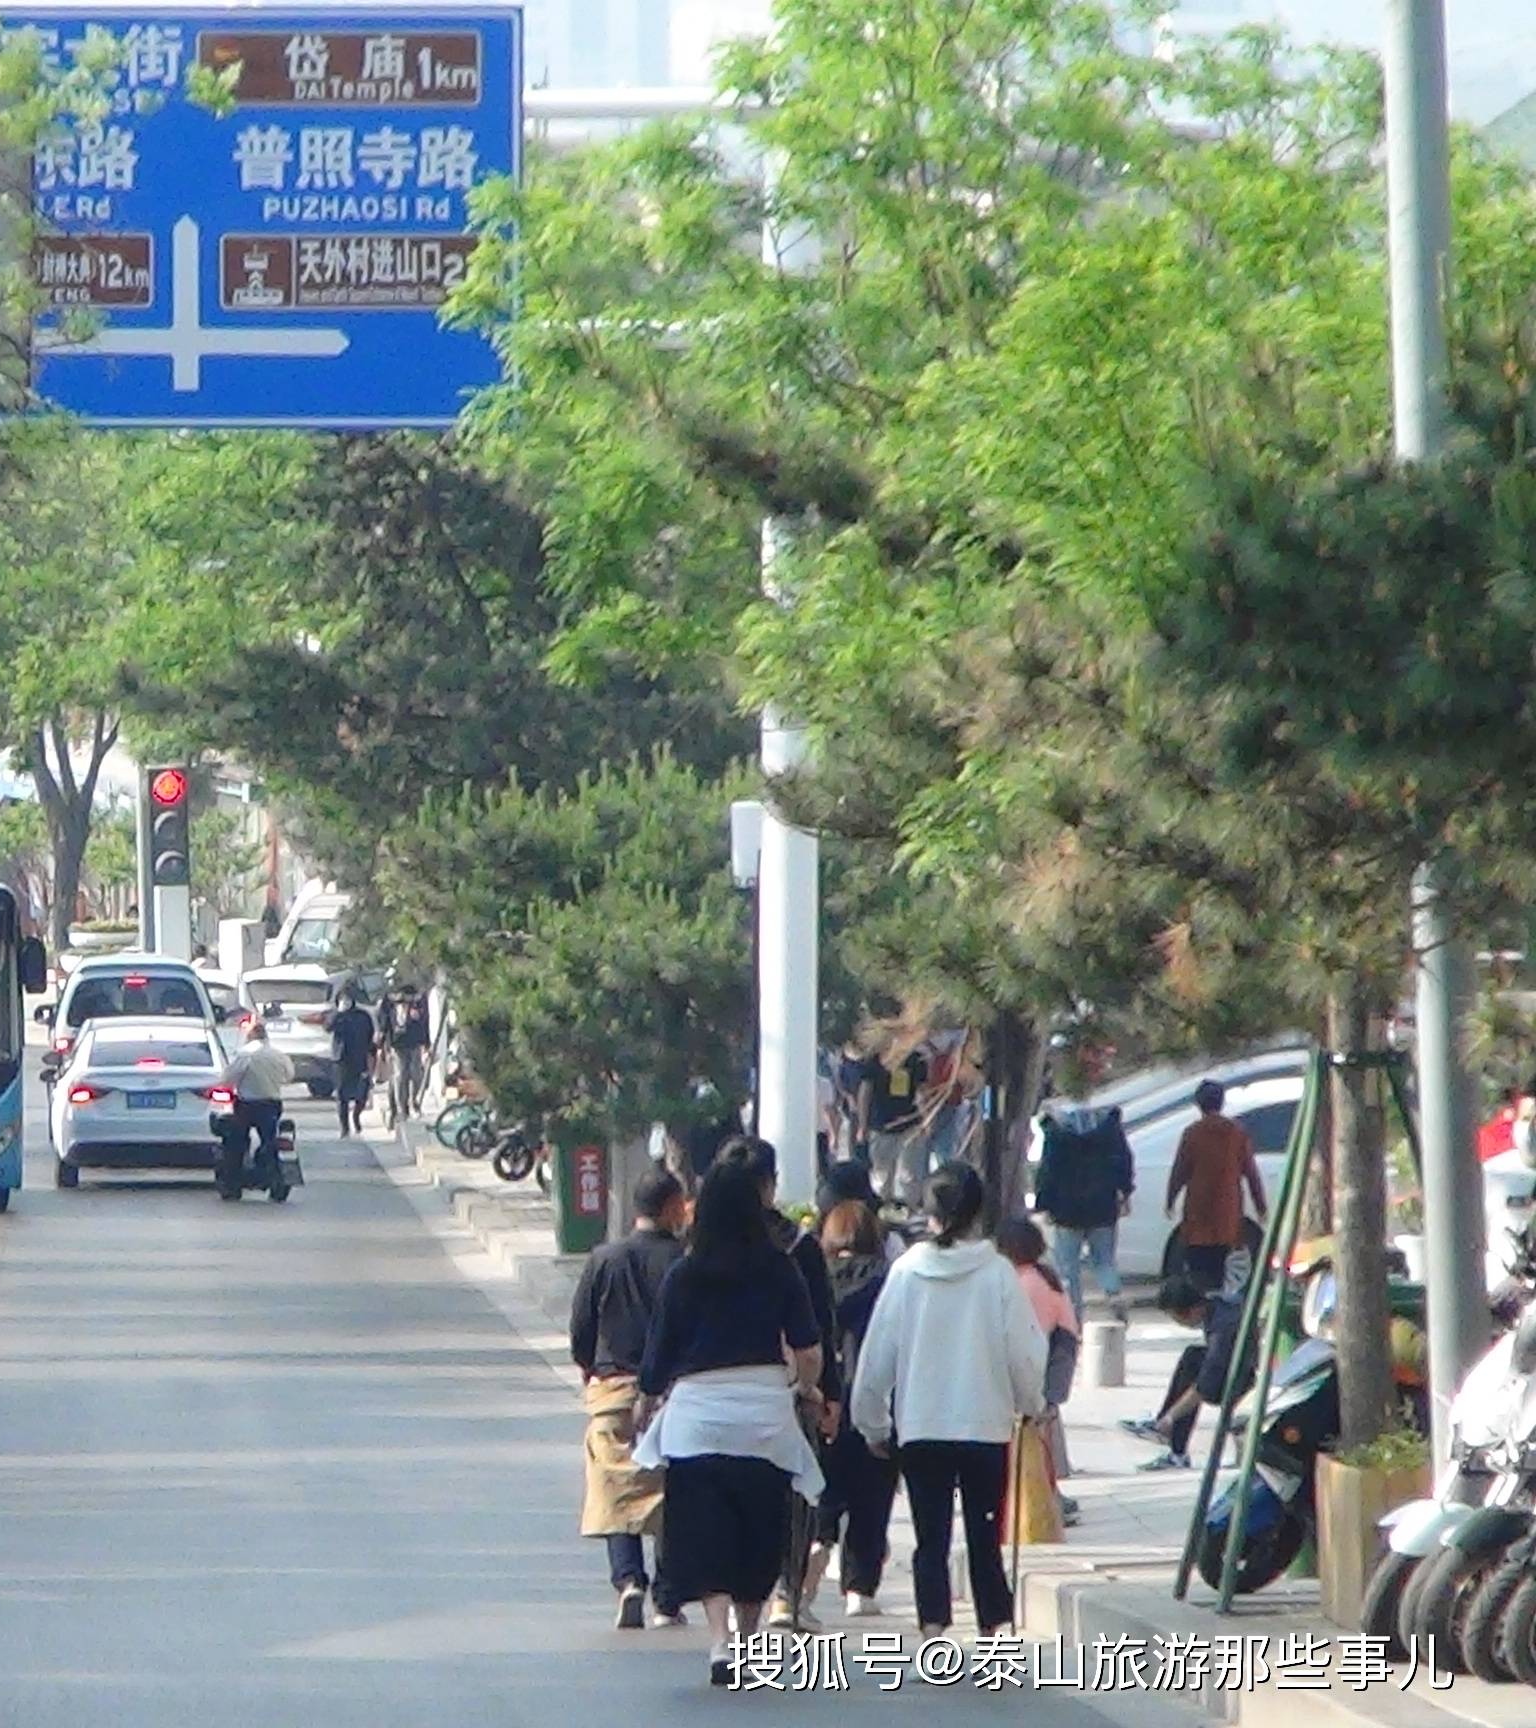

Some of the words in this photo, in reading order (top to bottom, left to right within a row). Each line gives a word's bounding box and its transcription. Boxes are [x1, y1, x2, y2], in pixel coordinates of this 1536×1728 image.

[418, 47, 478, 88] 1km
[330, 76, 415, 103] Temple
[232, 125, 479, 191] 普照寺路
[263, 196, 408, 221] PUZHAOSI
[416, 197, 451, 221] Rd
[299, 238, 443, 284] 天外村进山口
